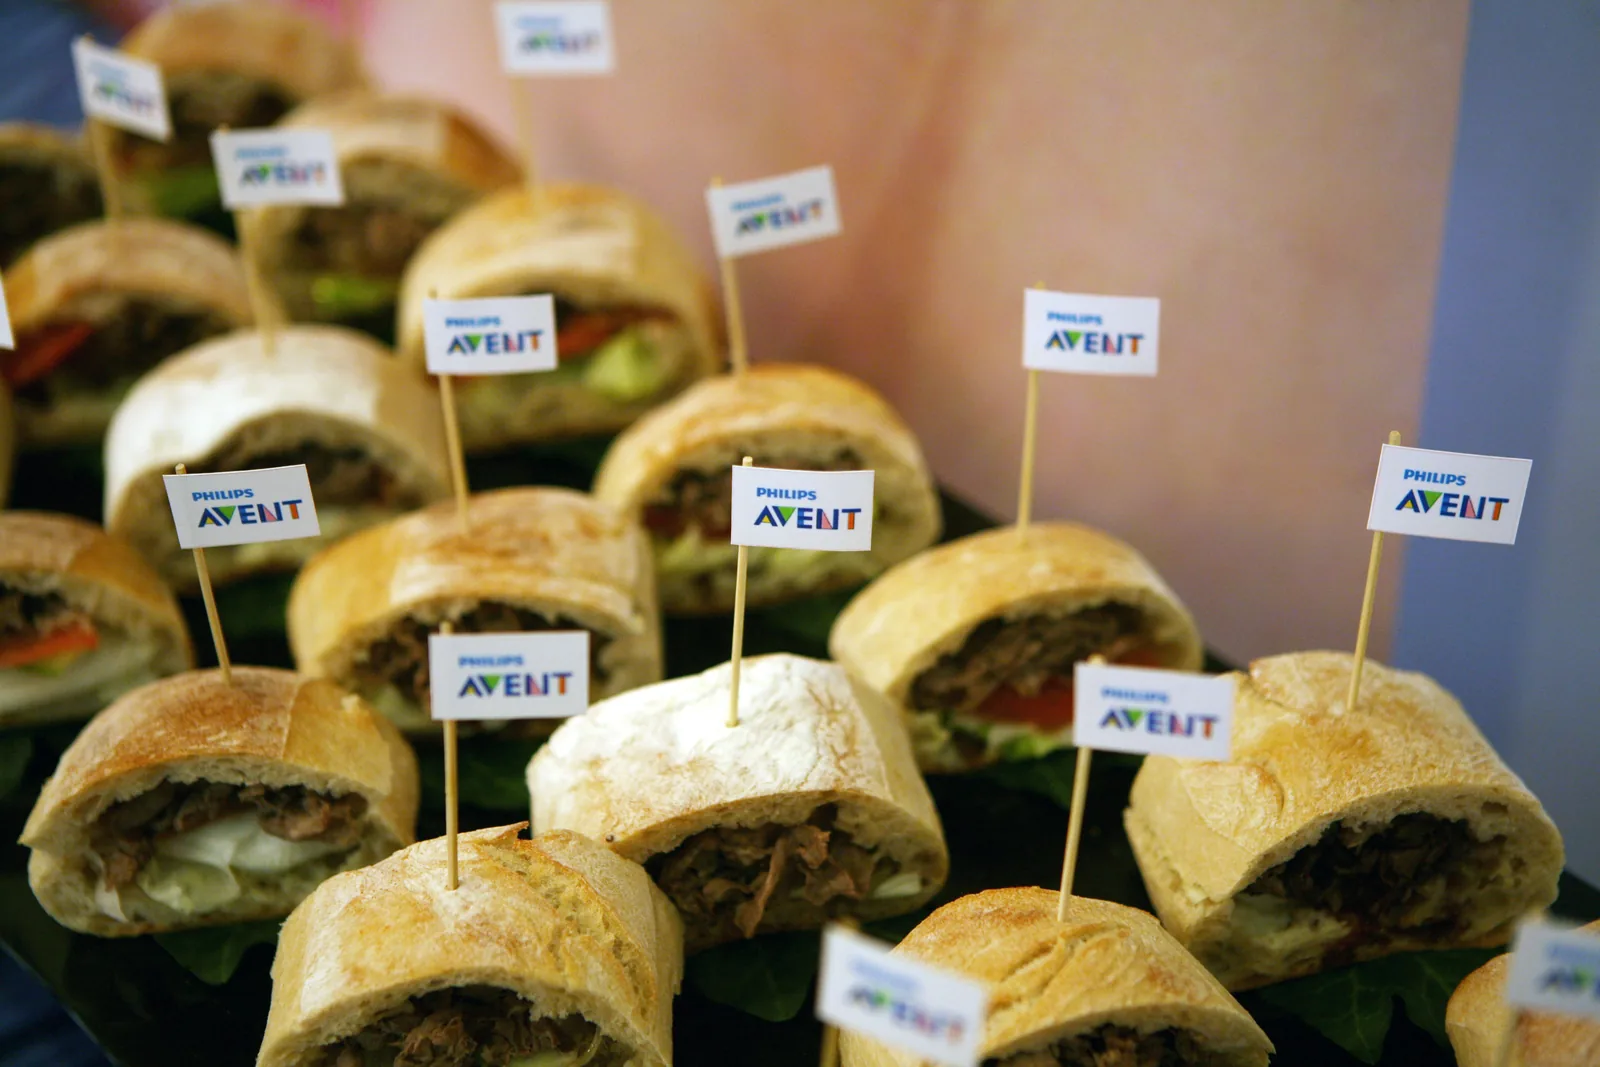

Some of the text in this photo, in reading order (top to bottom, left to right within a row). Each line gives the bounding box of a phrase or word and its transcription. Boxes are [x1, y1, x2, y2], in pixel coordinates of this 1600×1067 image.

[447, 329, 544, 355] AVENT
[1045, 330, 1144, 355] AVENT
[1403, 468, 1467, 487] PHILIPS
[192, 488, 254, 502] PHILIPS
[756, 486, 817, 501] PHILIPS
[1395, 488, 1510, 521] AVENT
[198, 499, 303, 528] AVENT
[753, 505, 862, 530] AVENT
[457, 672, 573, 698] AVENT
[1099, 708, 1220, 740] AVENT
